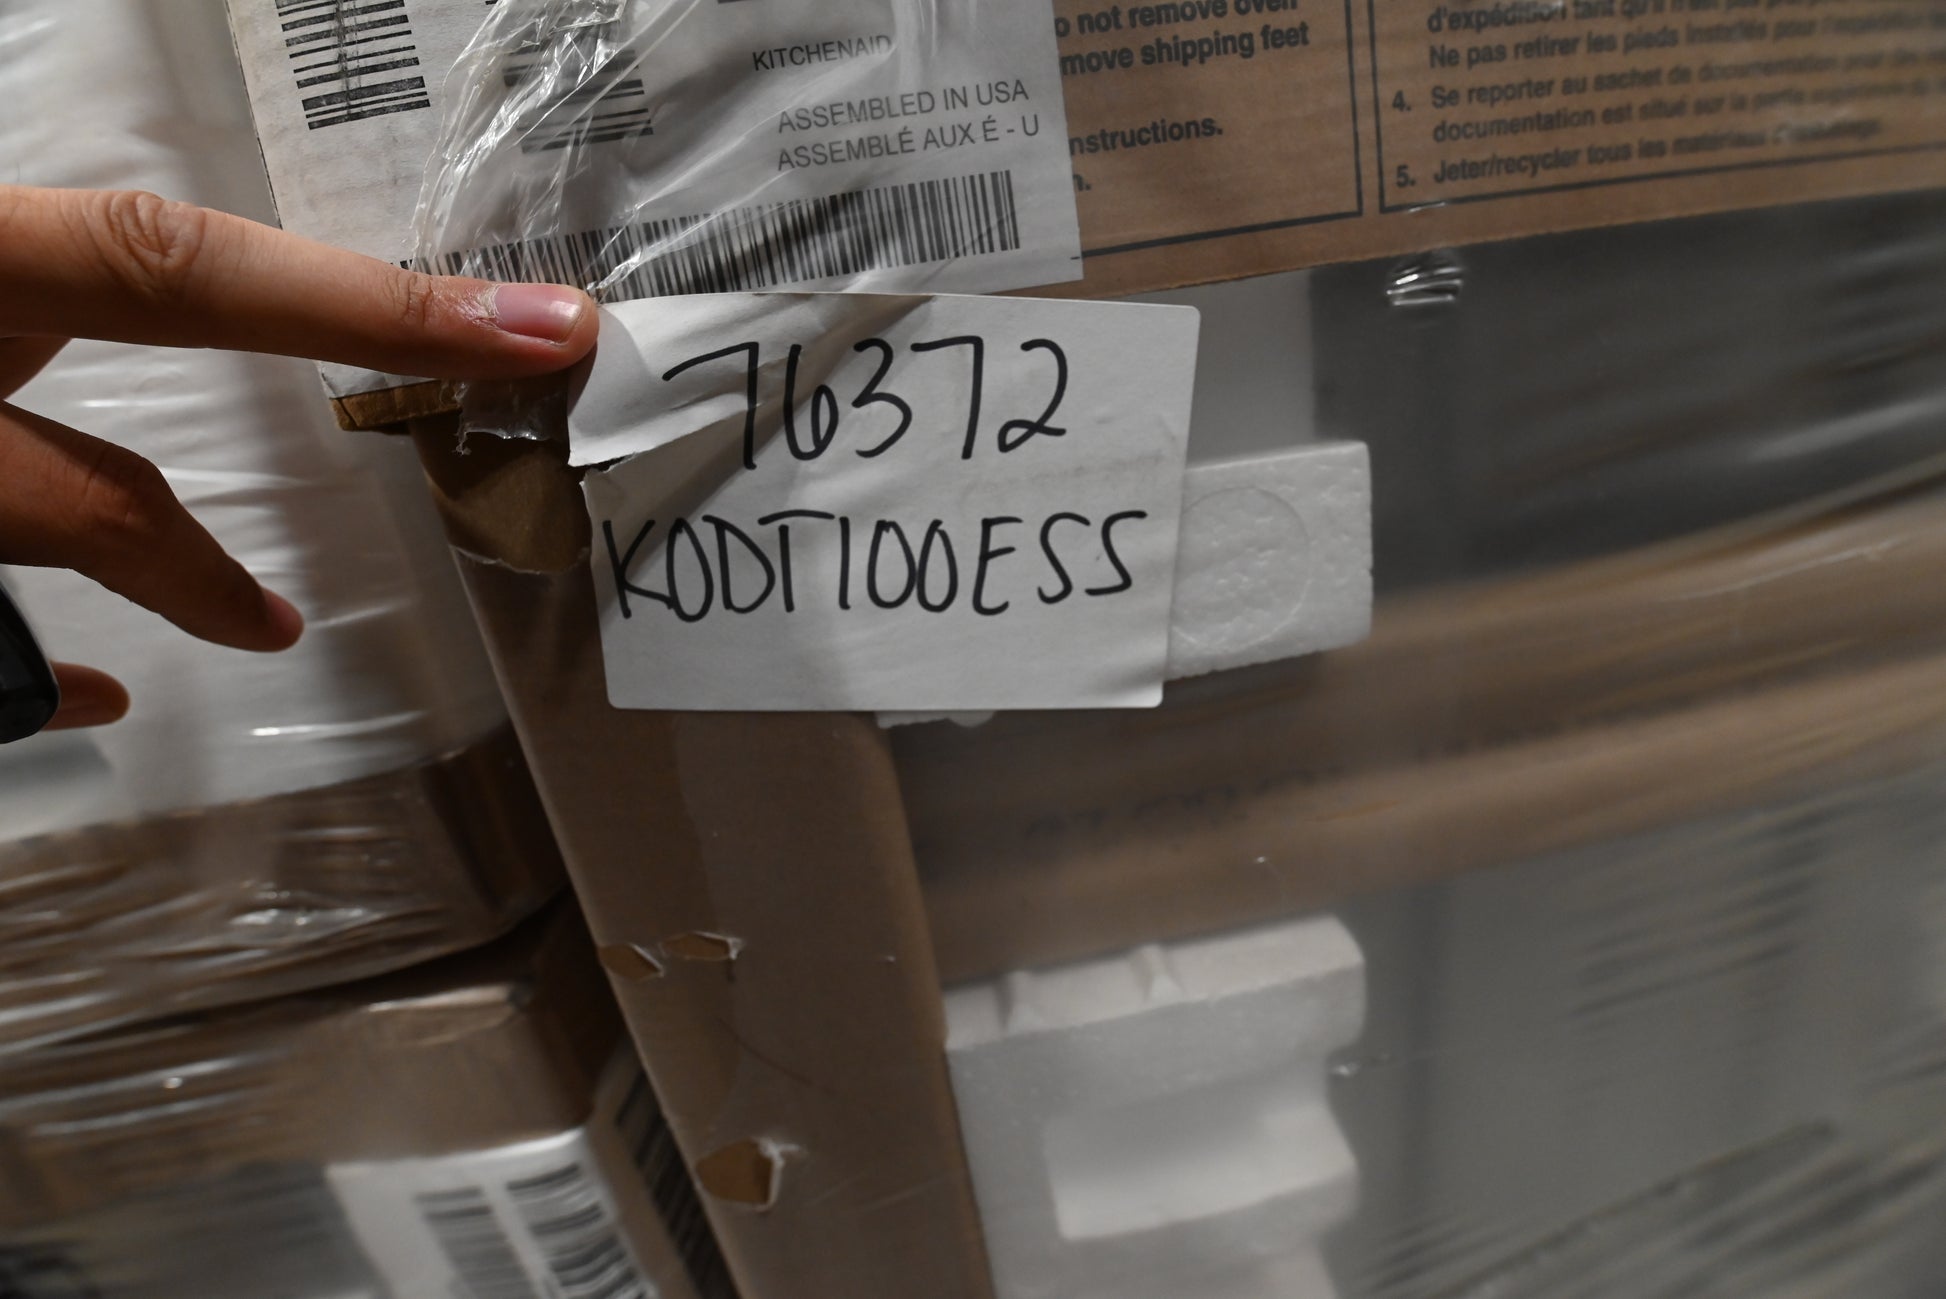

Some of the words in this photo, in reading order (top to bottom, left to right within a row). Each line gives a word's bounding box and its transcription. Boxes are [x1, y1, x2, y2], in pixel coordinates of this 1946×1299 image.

[1077, 6, 1123, 33] not
[1129, 0, 1228, 29] remove
[1234, 0, 1298, 16] oven
[753, 34, 892, 71] KITCHENAID
[1141, 31, 1255, 67] shipping
[1261, 21, 1310, 49] feet
[1429, 45, 1460, 69] Ne
[1467, 44, 1507, 69] pas
[1514, 34, 1580, 60] retirer
[778, 91, 936, 133] ASSEMBLED
[943, 86, 968, 111] IN
[976, 79, 1029, 106] USA
[1392, 90, 1412, 112] 4.
[1431, 85, 1460, 109] Se
[1467, 79, 1555, 107] reporter
[1561, 76, 1587, 96] au
[777, 127, 916, 171] ASSEMBLÉ
[923, 123, 975, 151] AUX
[982, 115, 1000, 142] É
[1021, 114, 1039, 137] U
[1433, 108, 1595, 143] documentation
[1602, 103, 1633, 125] est
[1396, 165, 1415, 188] 5.
[1433, 147, 1579, 184] Jeter/recycler
[1587, 141, 1632, 165] tous
[662, 335, 1068, 470] 76372
[602, 509, 1148, 623] KODT100ESS
